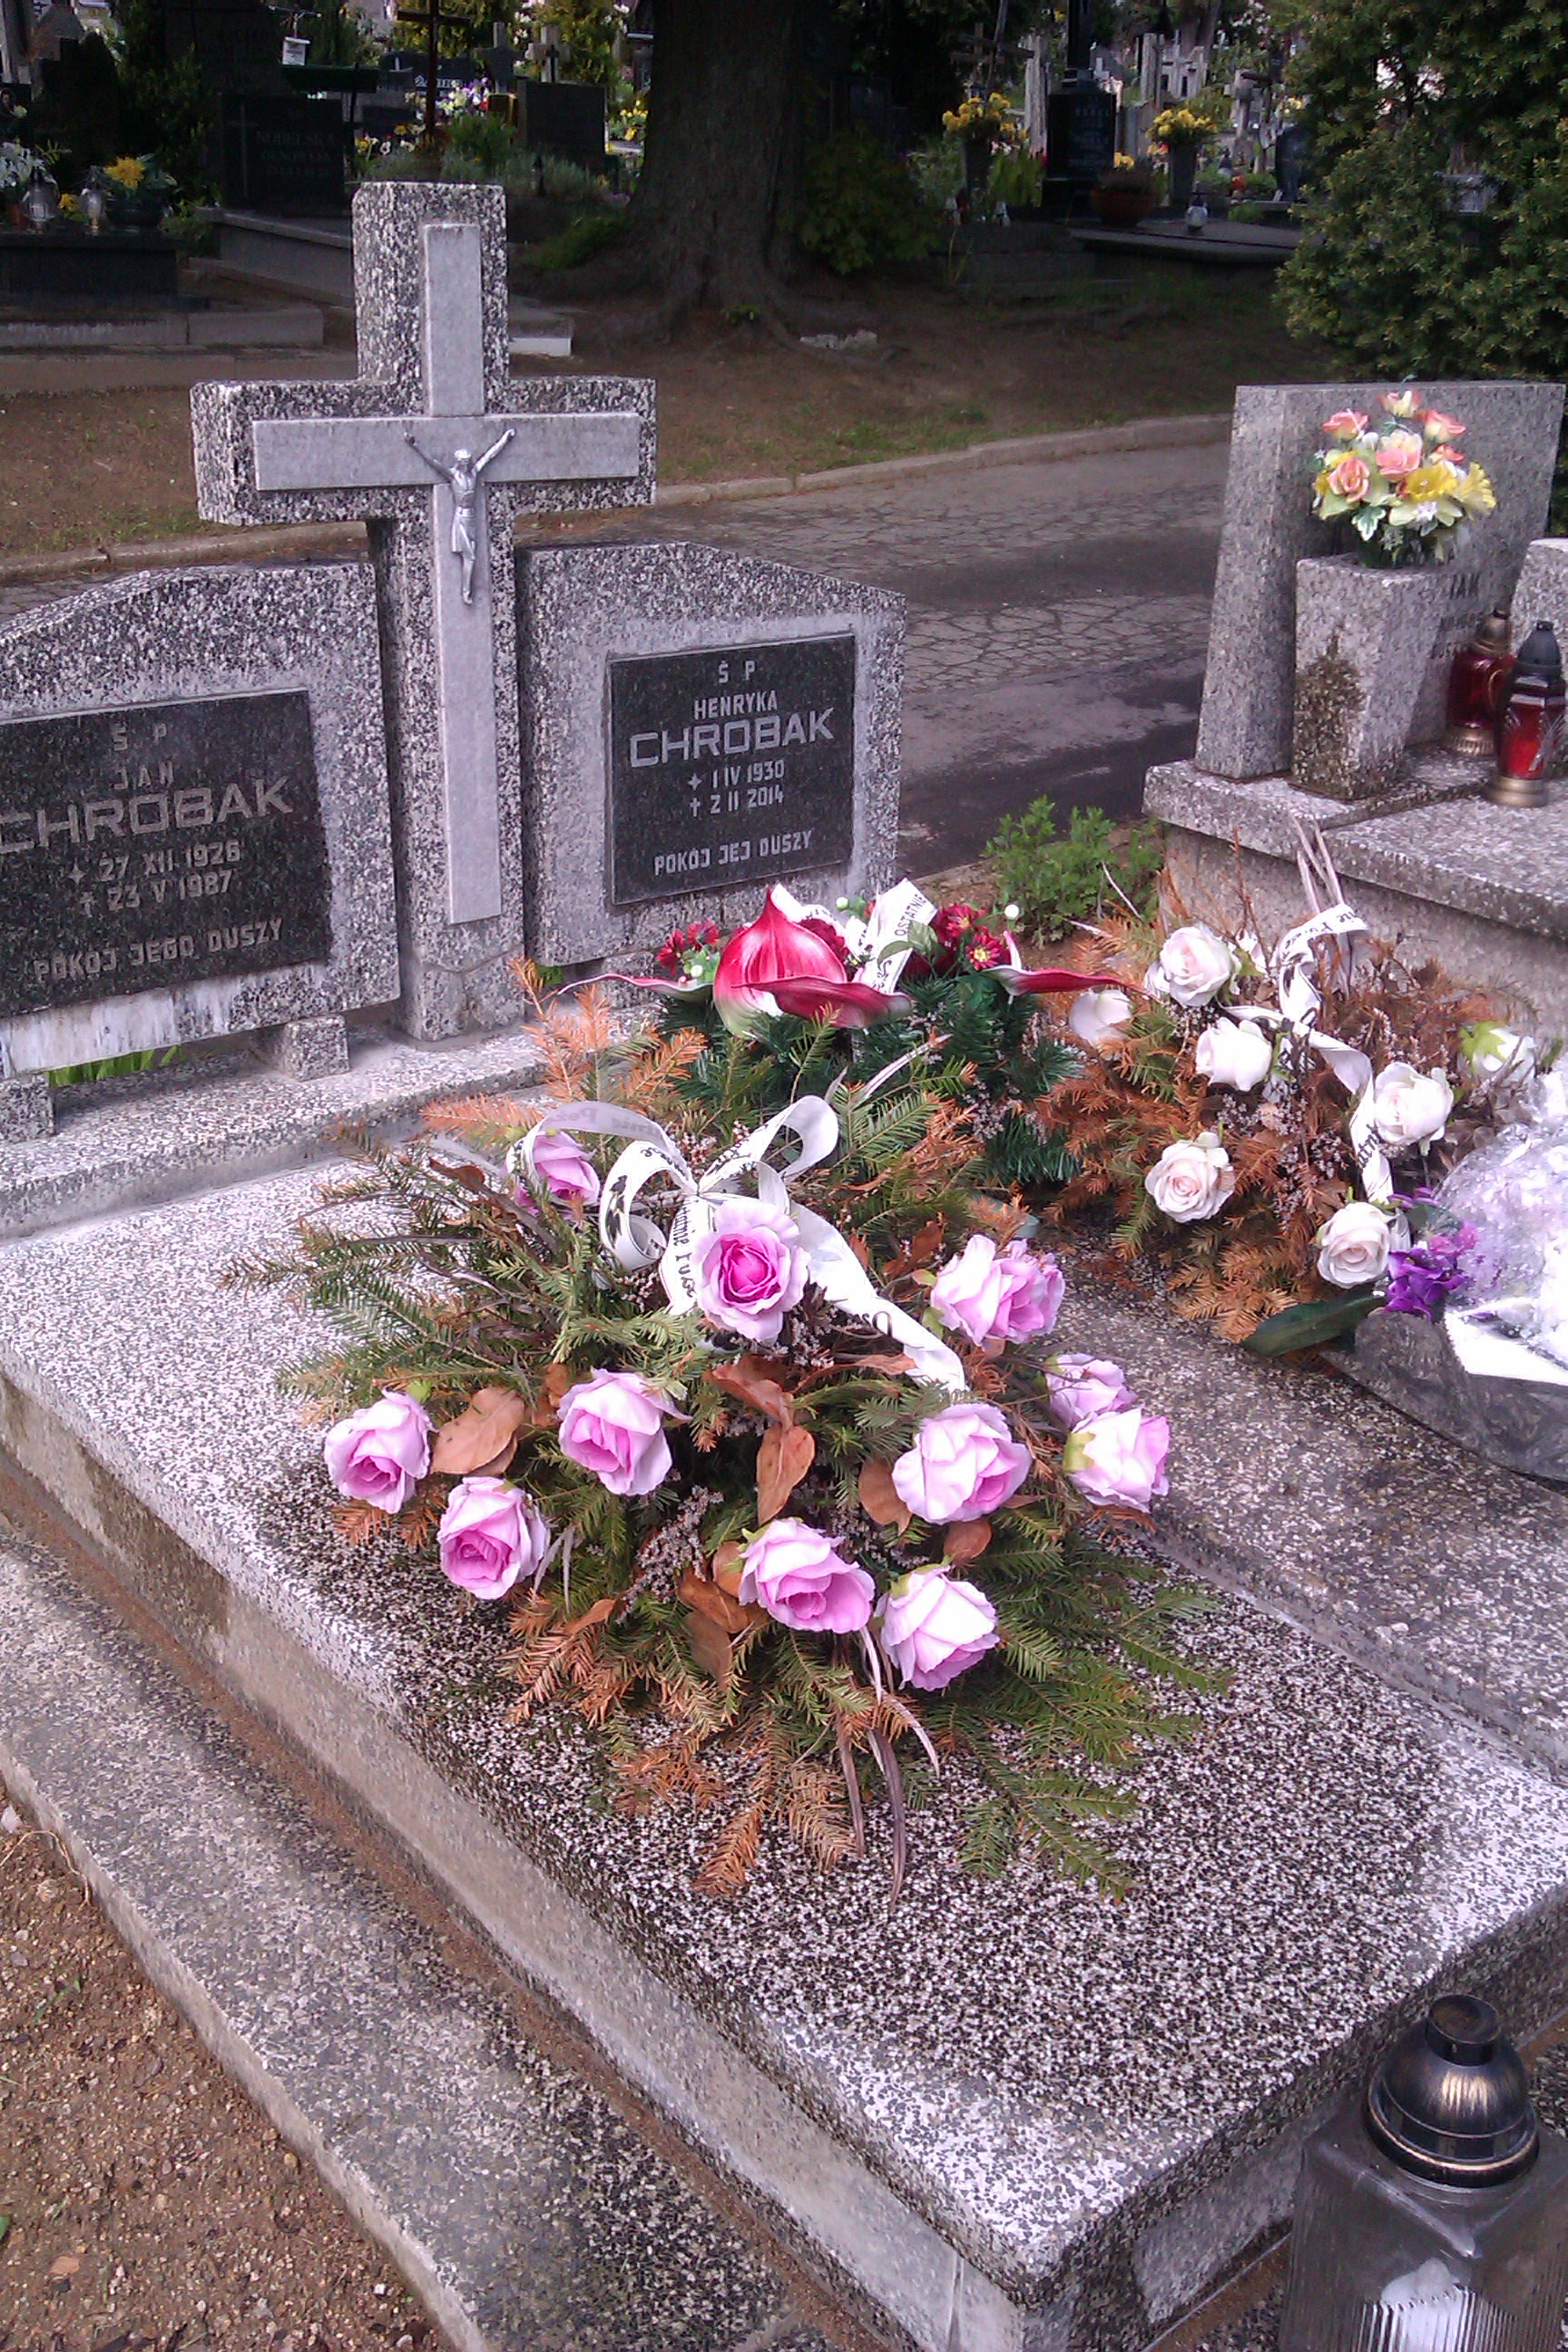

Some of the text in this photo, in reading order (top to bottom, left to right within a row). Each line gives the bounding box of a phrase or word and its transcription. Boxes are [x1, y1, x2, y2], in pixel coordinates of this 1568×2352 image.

[745, 660, 756, 681] P
[694, 690, 779, 720] HENRYKA
[152, 722, 168, 746] P
[629, 707, 836, 768] CHROBAK
[111, 760, 174, 790] JAN
[724, 765, 741, 788] IV
[747, 759, 786, 783] 1930
[0, 777, 294, 855] CHROBAK
[710, 784, 785, 815] 2 II 2014
[97, 838, 241, 883] 27 XII 1926
[718, 840, 751, 866] JEJ
[759, 829, 812, 858] DUSZY
[107, 868, 233, 911] 23 V 1987
[129, 936, 193, 966] JEGO
[206, 917, 284, 954] DUSZY
